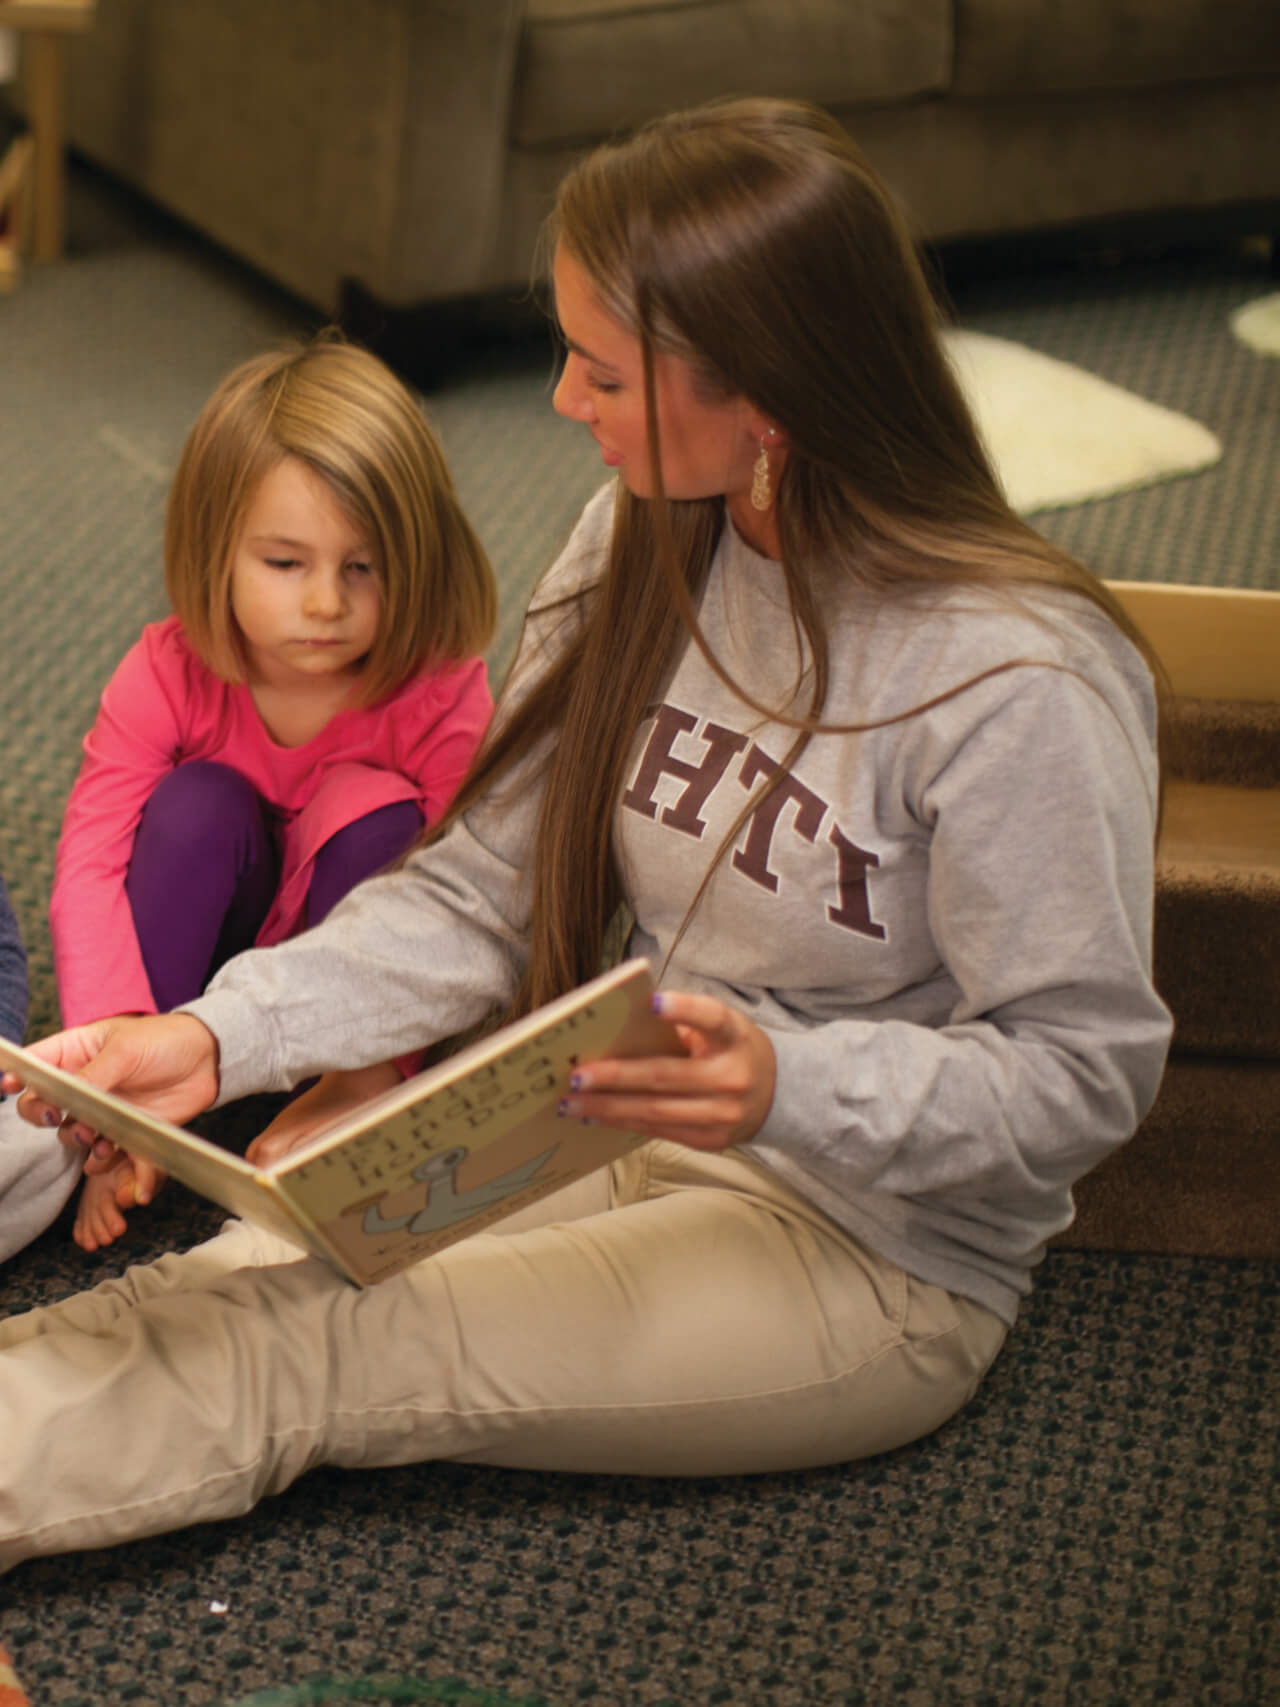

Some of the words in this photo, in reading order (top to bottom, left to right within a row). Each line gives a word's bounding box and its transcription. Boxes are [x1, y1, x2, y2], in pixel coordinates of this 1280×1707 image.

[347, 1082, 503, 1173] Finds
[523, 1054, 552, 1079] a
[407, 1006, 598, 1120] Pigeon
[357, 1138, 442, 1189] Hot
